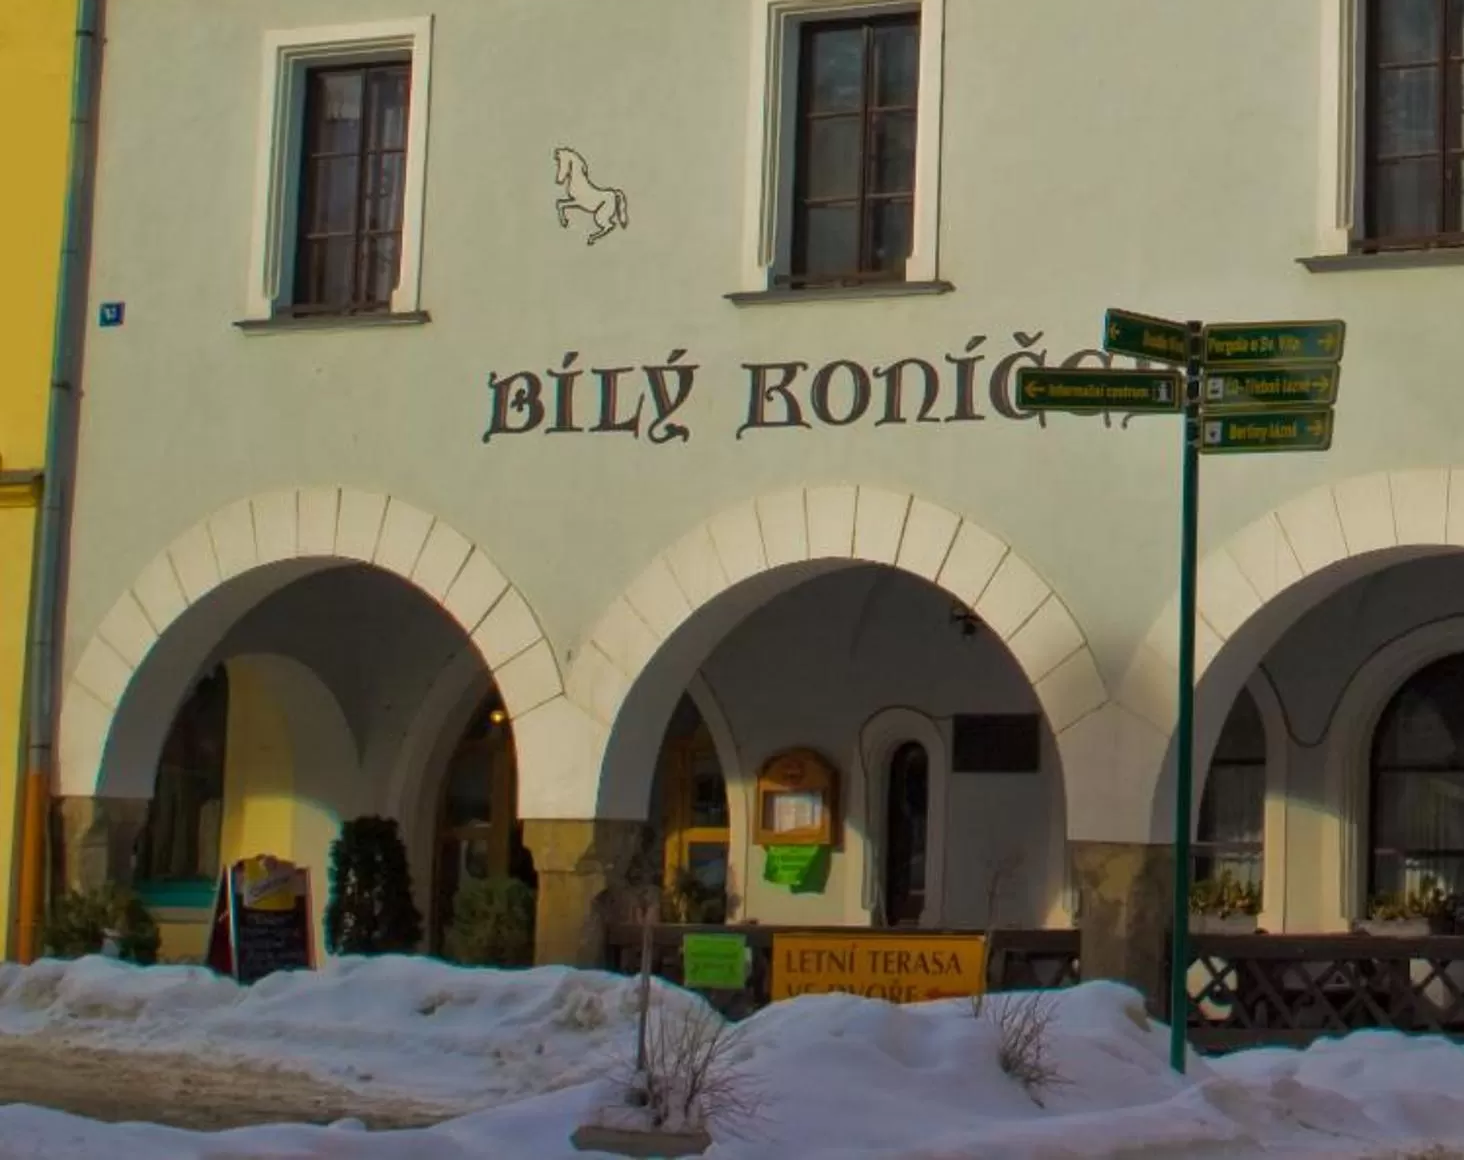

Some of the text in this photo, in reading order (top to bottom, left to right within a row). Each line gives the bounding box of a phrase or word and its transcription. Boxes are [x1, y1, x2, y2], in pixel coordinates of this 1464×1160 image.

[482, 331, 1176, 444] BÍLÝ KONÍČ
[785, 942, 963, 976] LETNÍ TERASA
